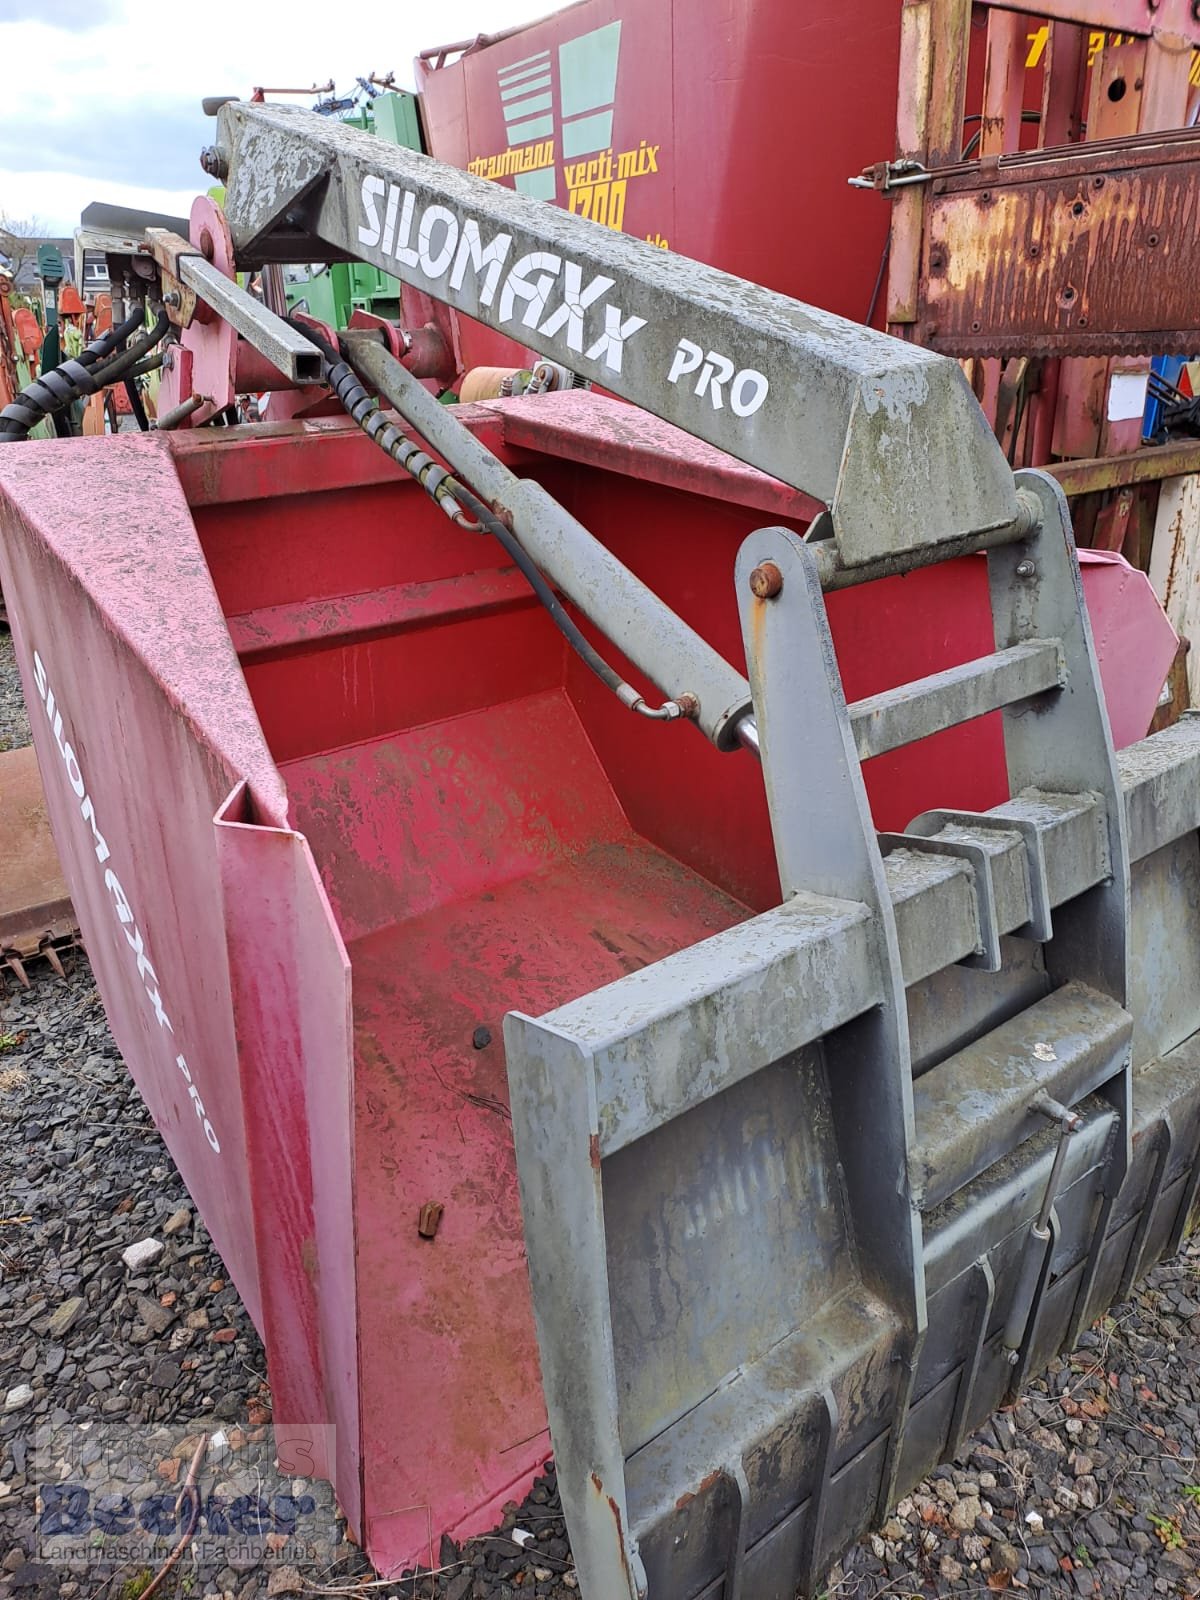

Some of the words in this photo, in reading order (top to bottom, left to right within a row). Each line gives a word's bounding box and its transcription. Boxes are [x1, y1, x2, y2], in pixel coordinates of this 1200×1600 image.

[563, 140, 660, 190] verti-mix
[667, 337, 769, 418] PRO
[175, 1053, 221, 1154] PRO
